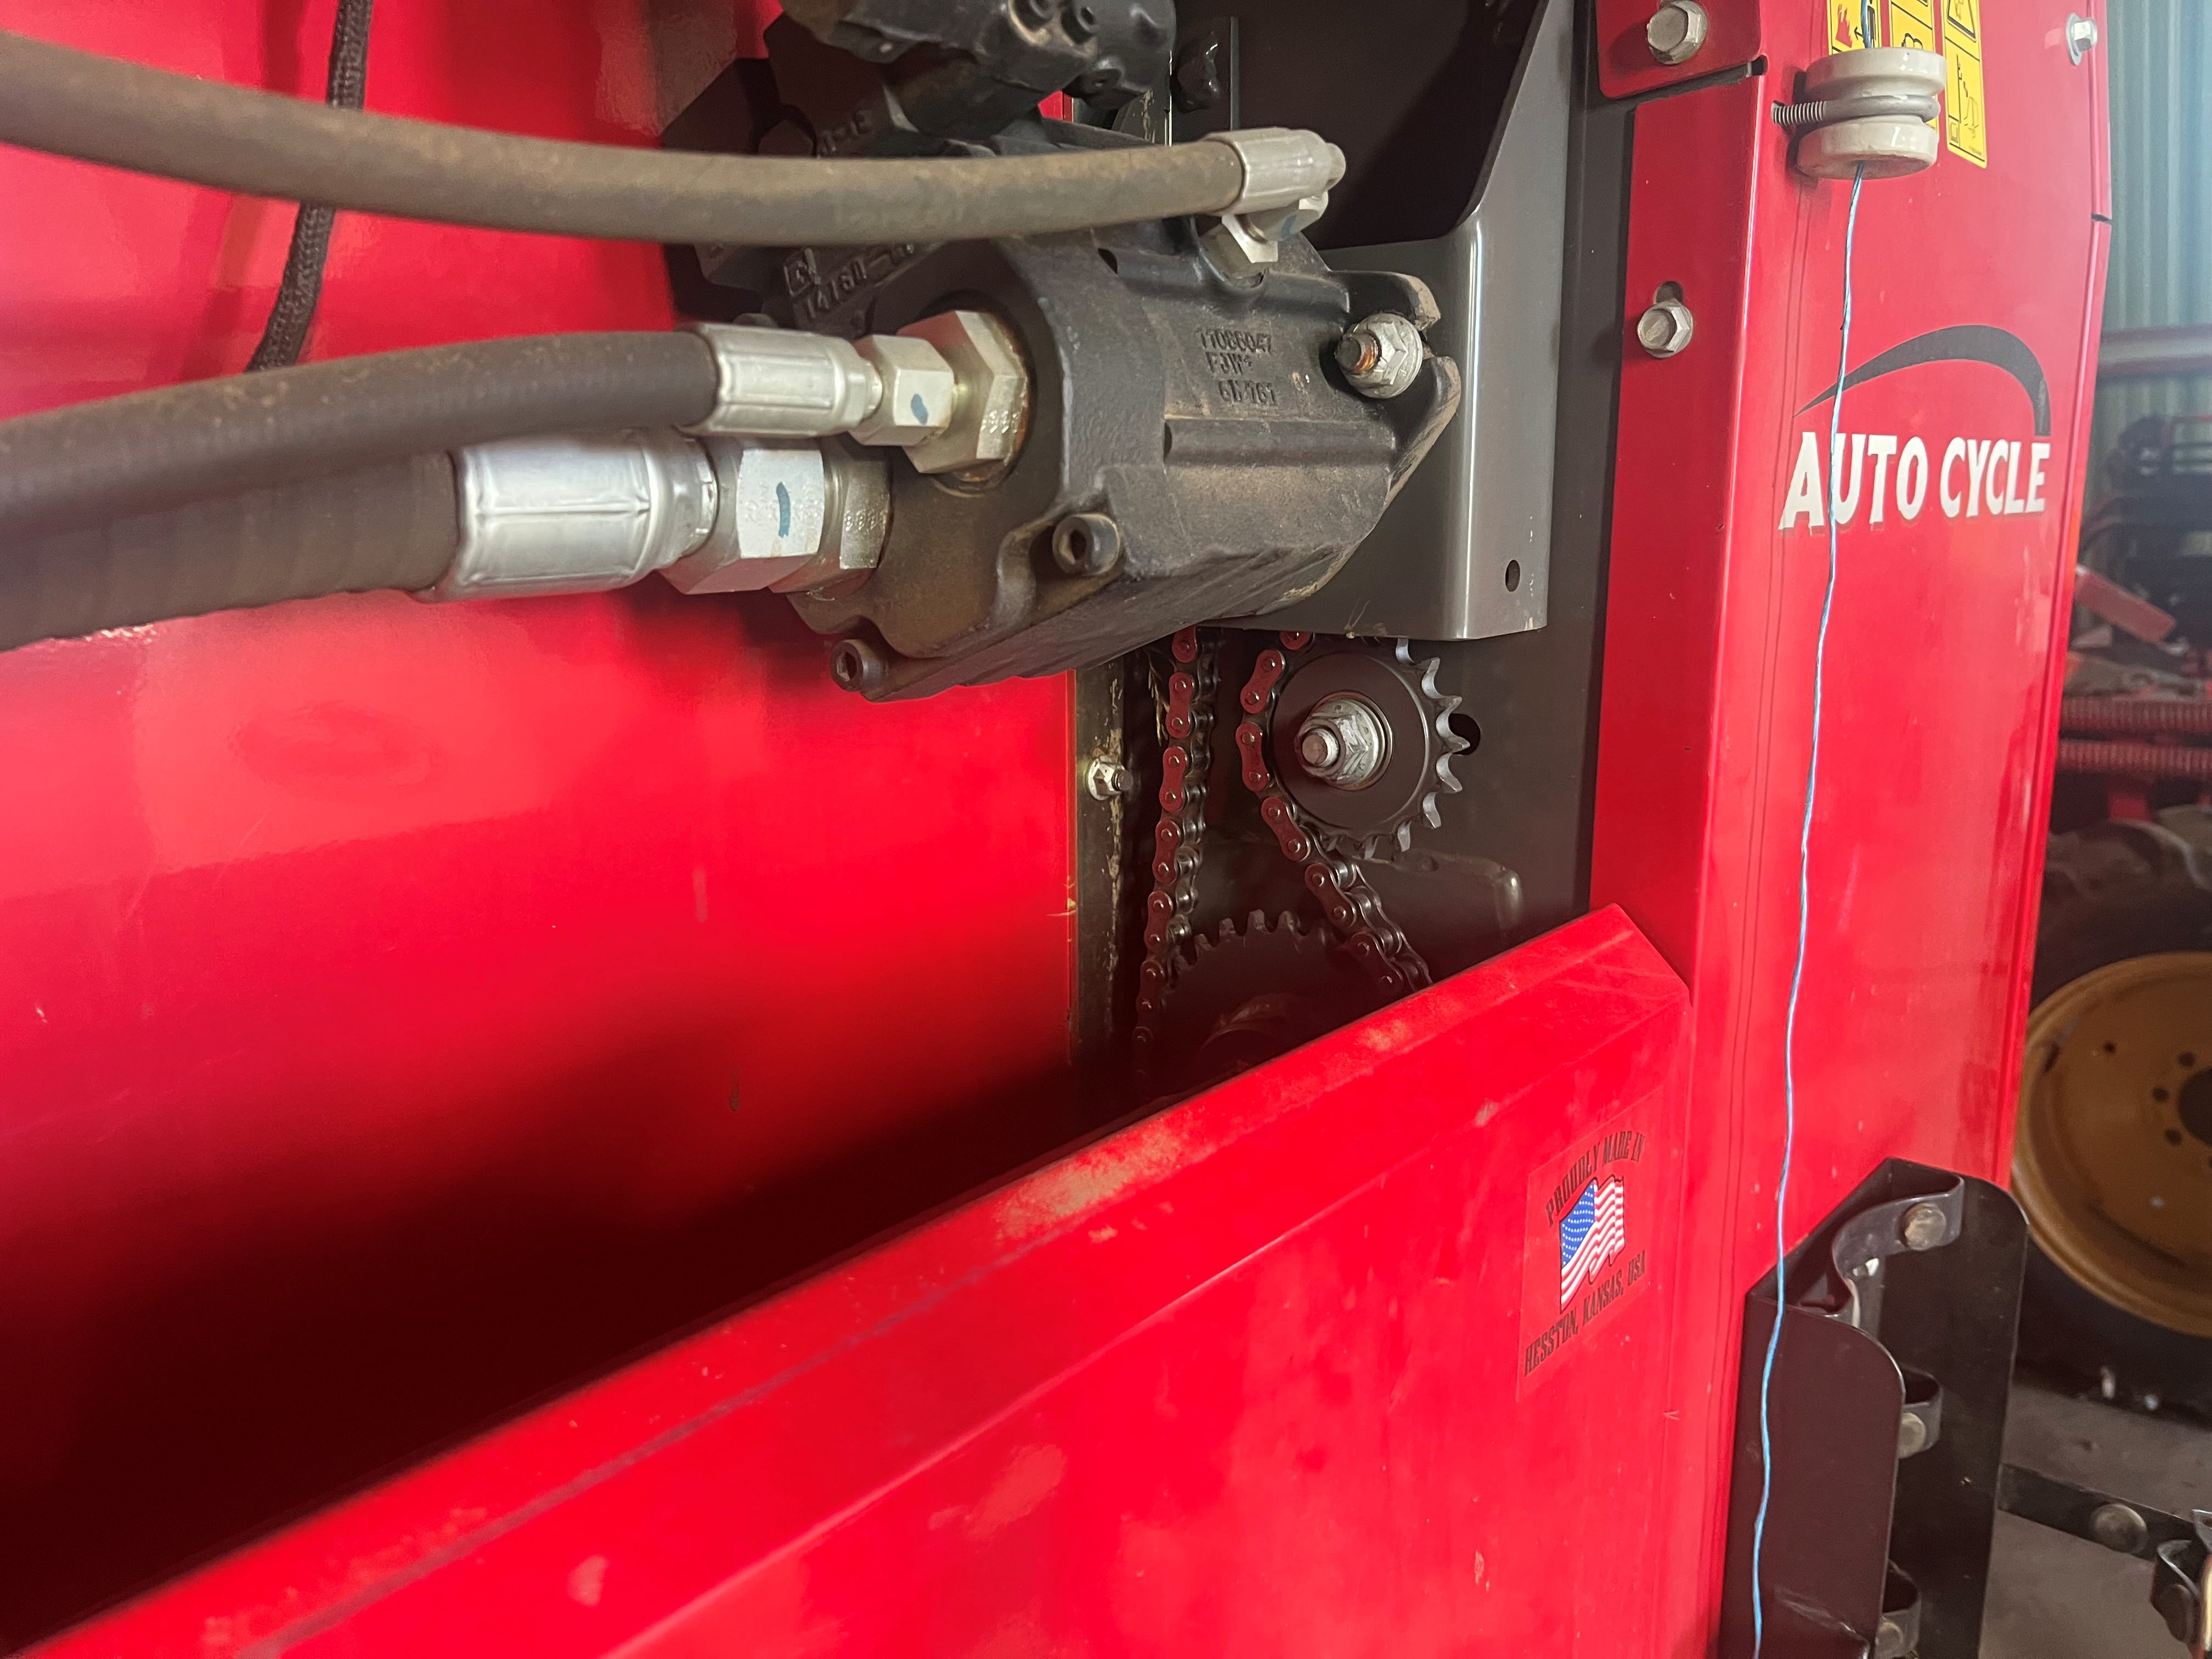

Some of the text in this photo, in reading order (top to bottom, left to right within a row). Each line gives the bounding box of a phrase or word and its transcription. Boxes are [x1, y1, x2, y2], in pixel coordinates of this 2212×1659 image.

[1778, 431, 2050, 530] AUTO CYCLE
[1545, 1131, 1645, 1227] PROUDLY MADE IN
[1524, 1250, 1645, 1377] HESSTON, KANSAS, USA
